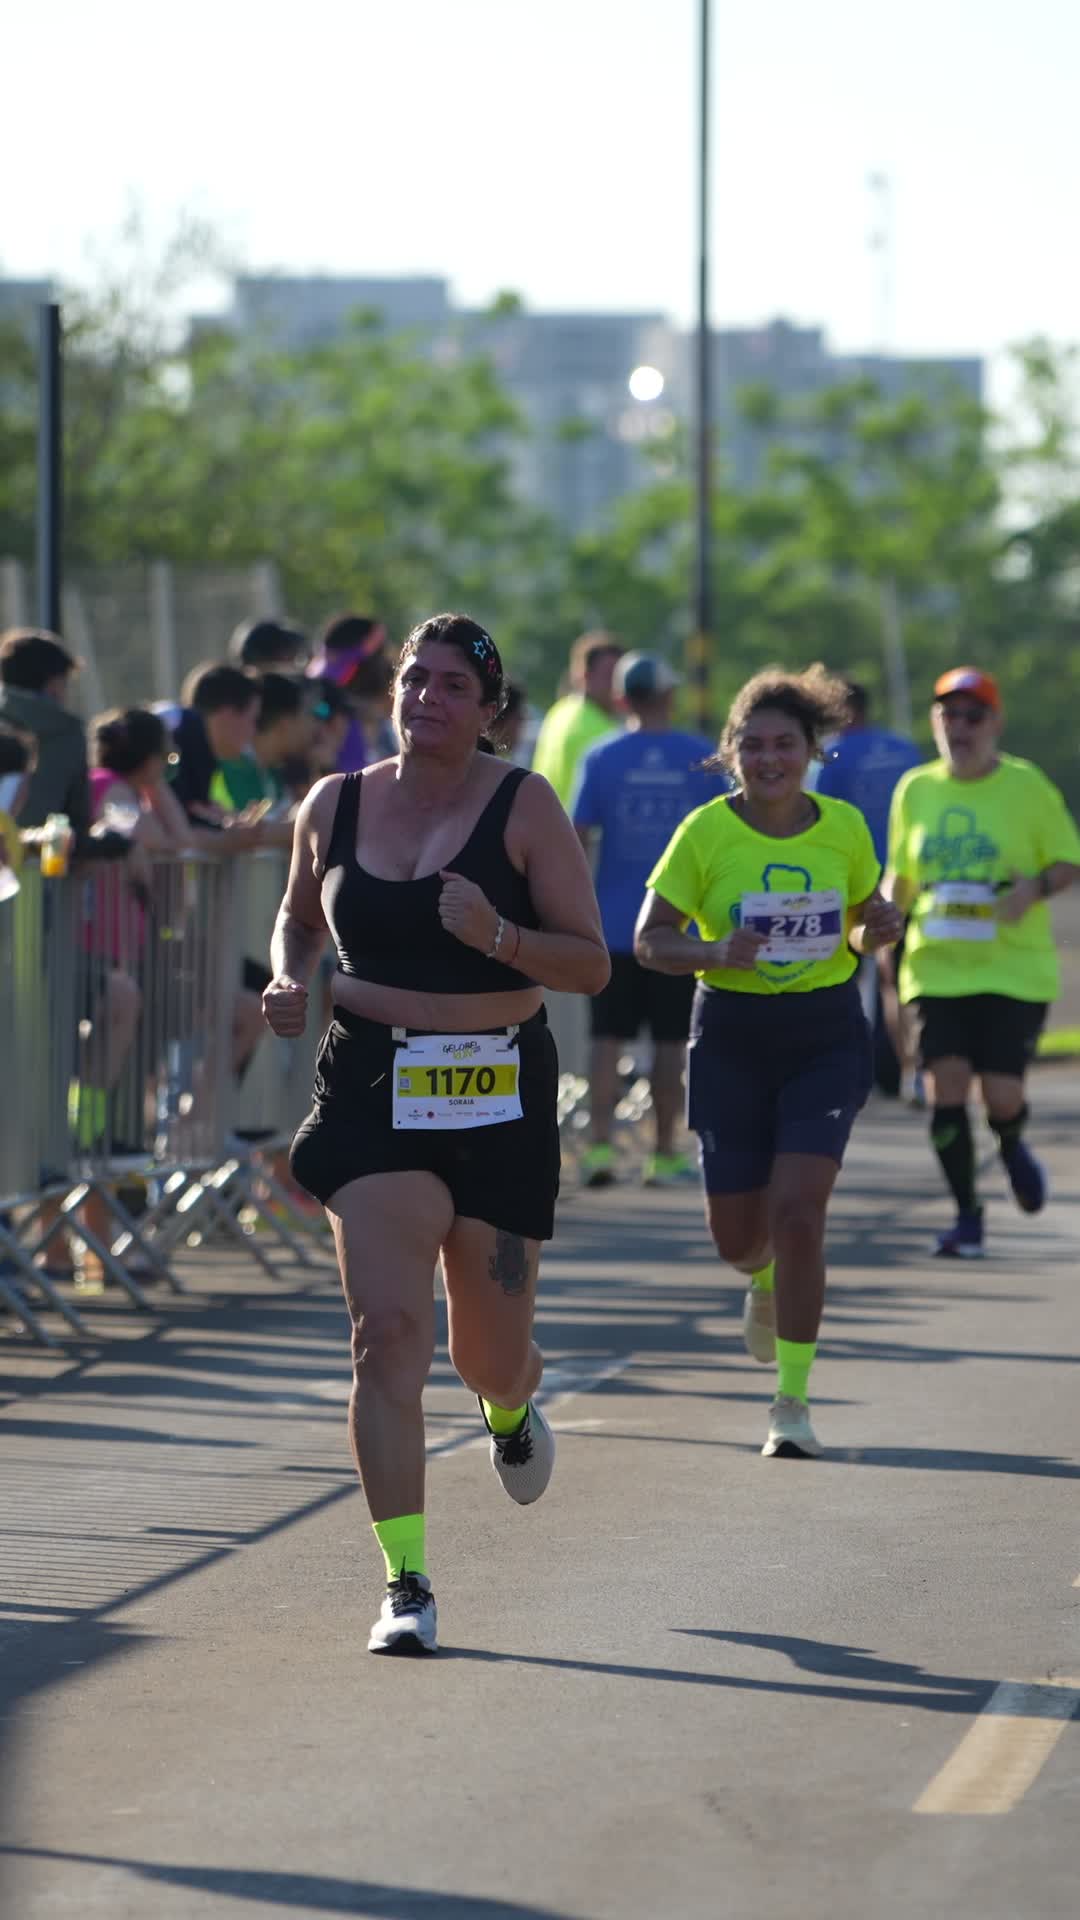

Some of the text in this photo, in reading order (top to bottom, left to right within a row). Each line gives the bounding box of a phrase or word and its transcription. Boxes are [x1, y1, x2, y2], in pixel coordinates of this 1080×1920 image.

[770, 915, 822, 937] 278
[425, 1067, 496, 1096] 1170
[448, 1098, 475, 1106] SORAIA
